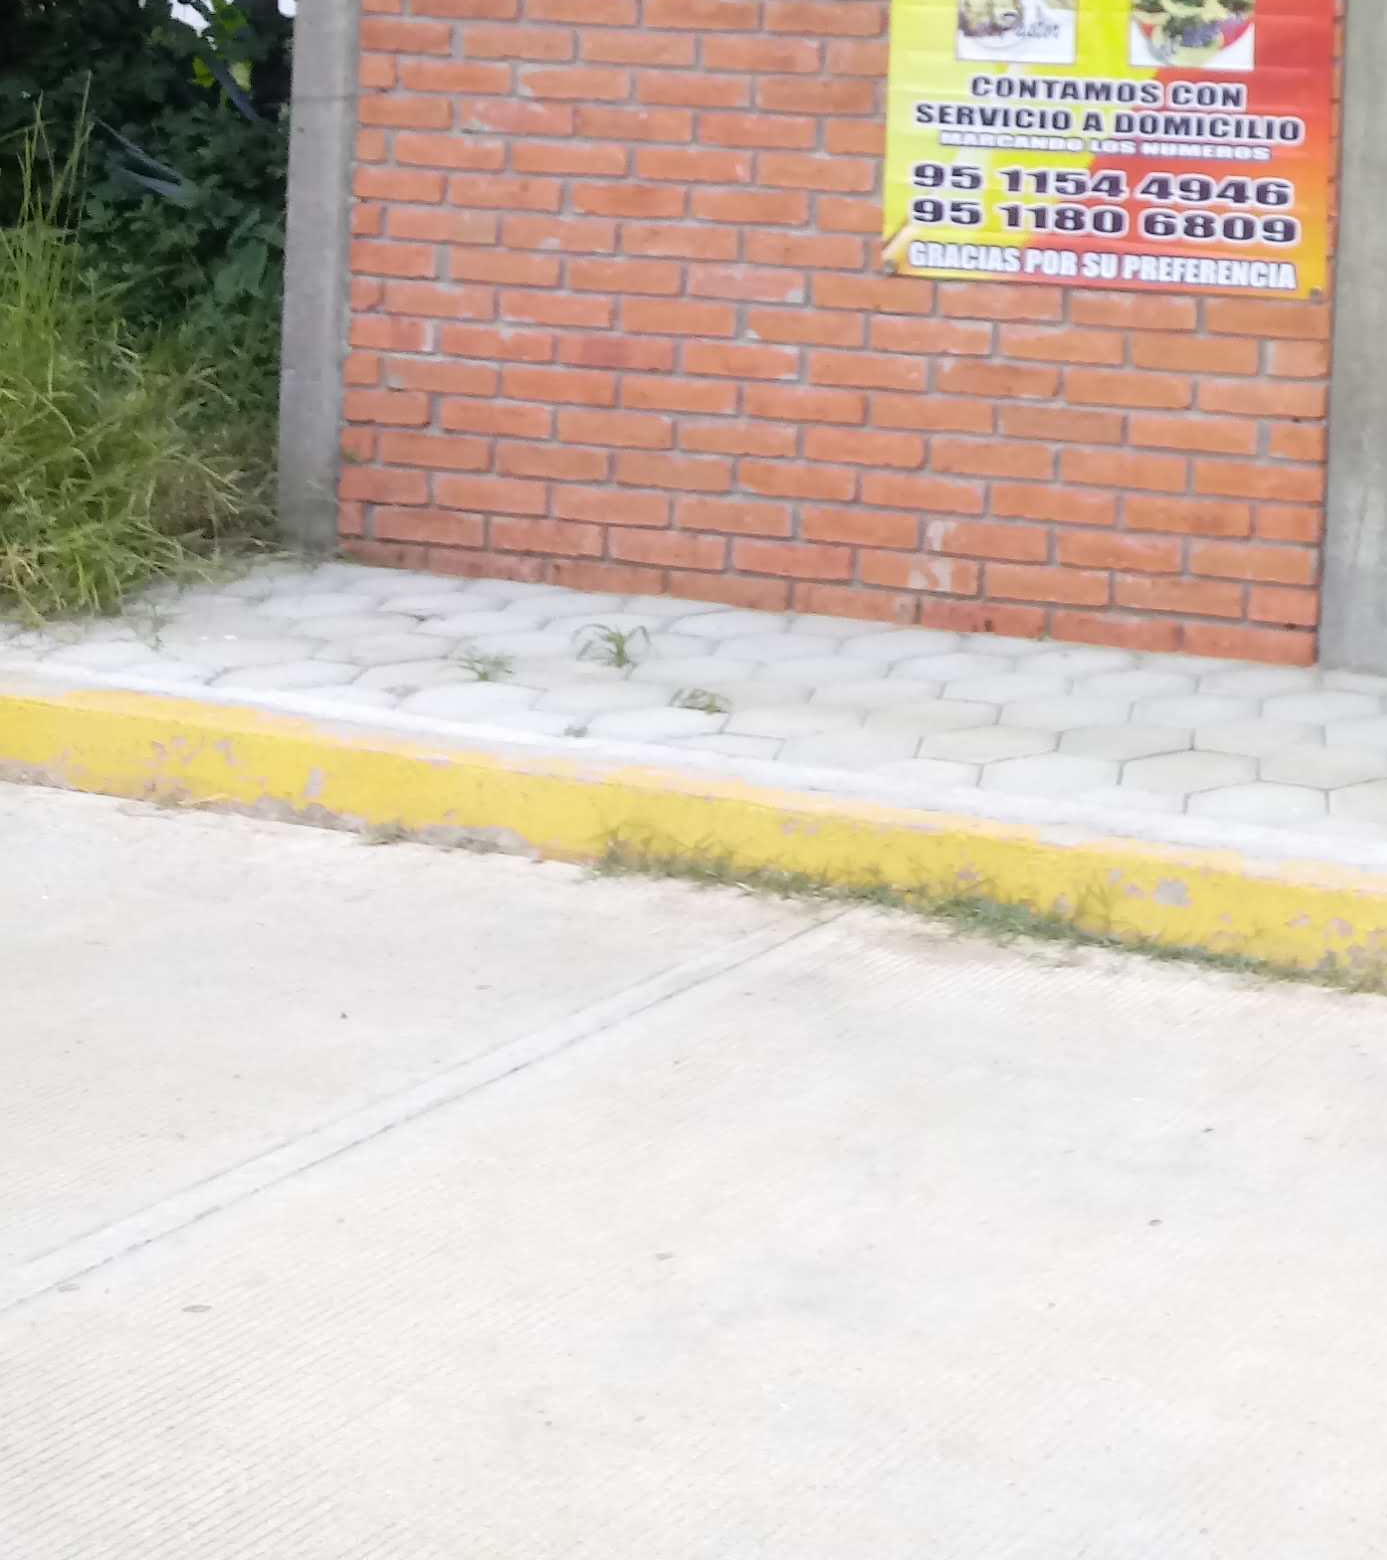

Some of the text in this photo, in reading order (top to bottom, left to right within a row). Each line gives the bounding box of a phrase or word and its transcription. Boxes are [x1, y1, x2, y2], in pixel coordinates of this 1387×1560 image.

[971, 76, 1244, 108] CONTAMOS CON
[915, 103, 1302, 142] SERVICIO A DOMICILIO
[940, 131, 1271, 161] MARCANDO LOS NUMEROS
[913, 164, 1292, 208] 95 1154 4946
[913, 200, 1298, 244] 95 1180 6809
[908, 241, 1297, 289] GRACIAS POR SU PREFERENCIA
